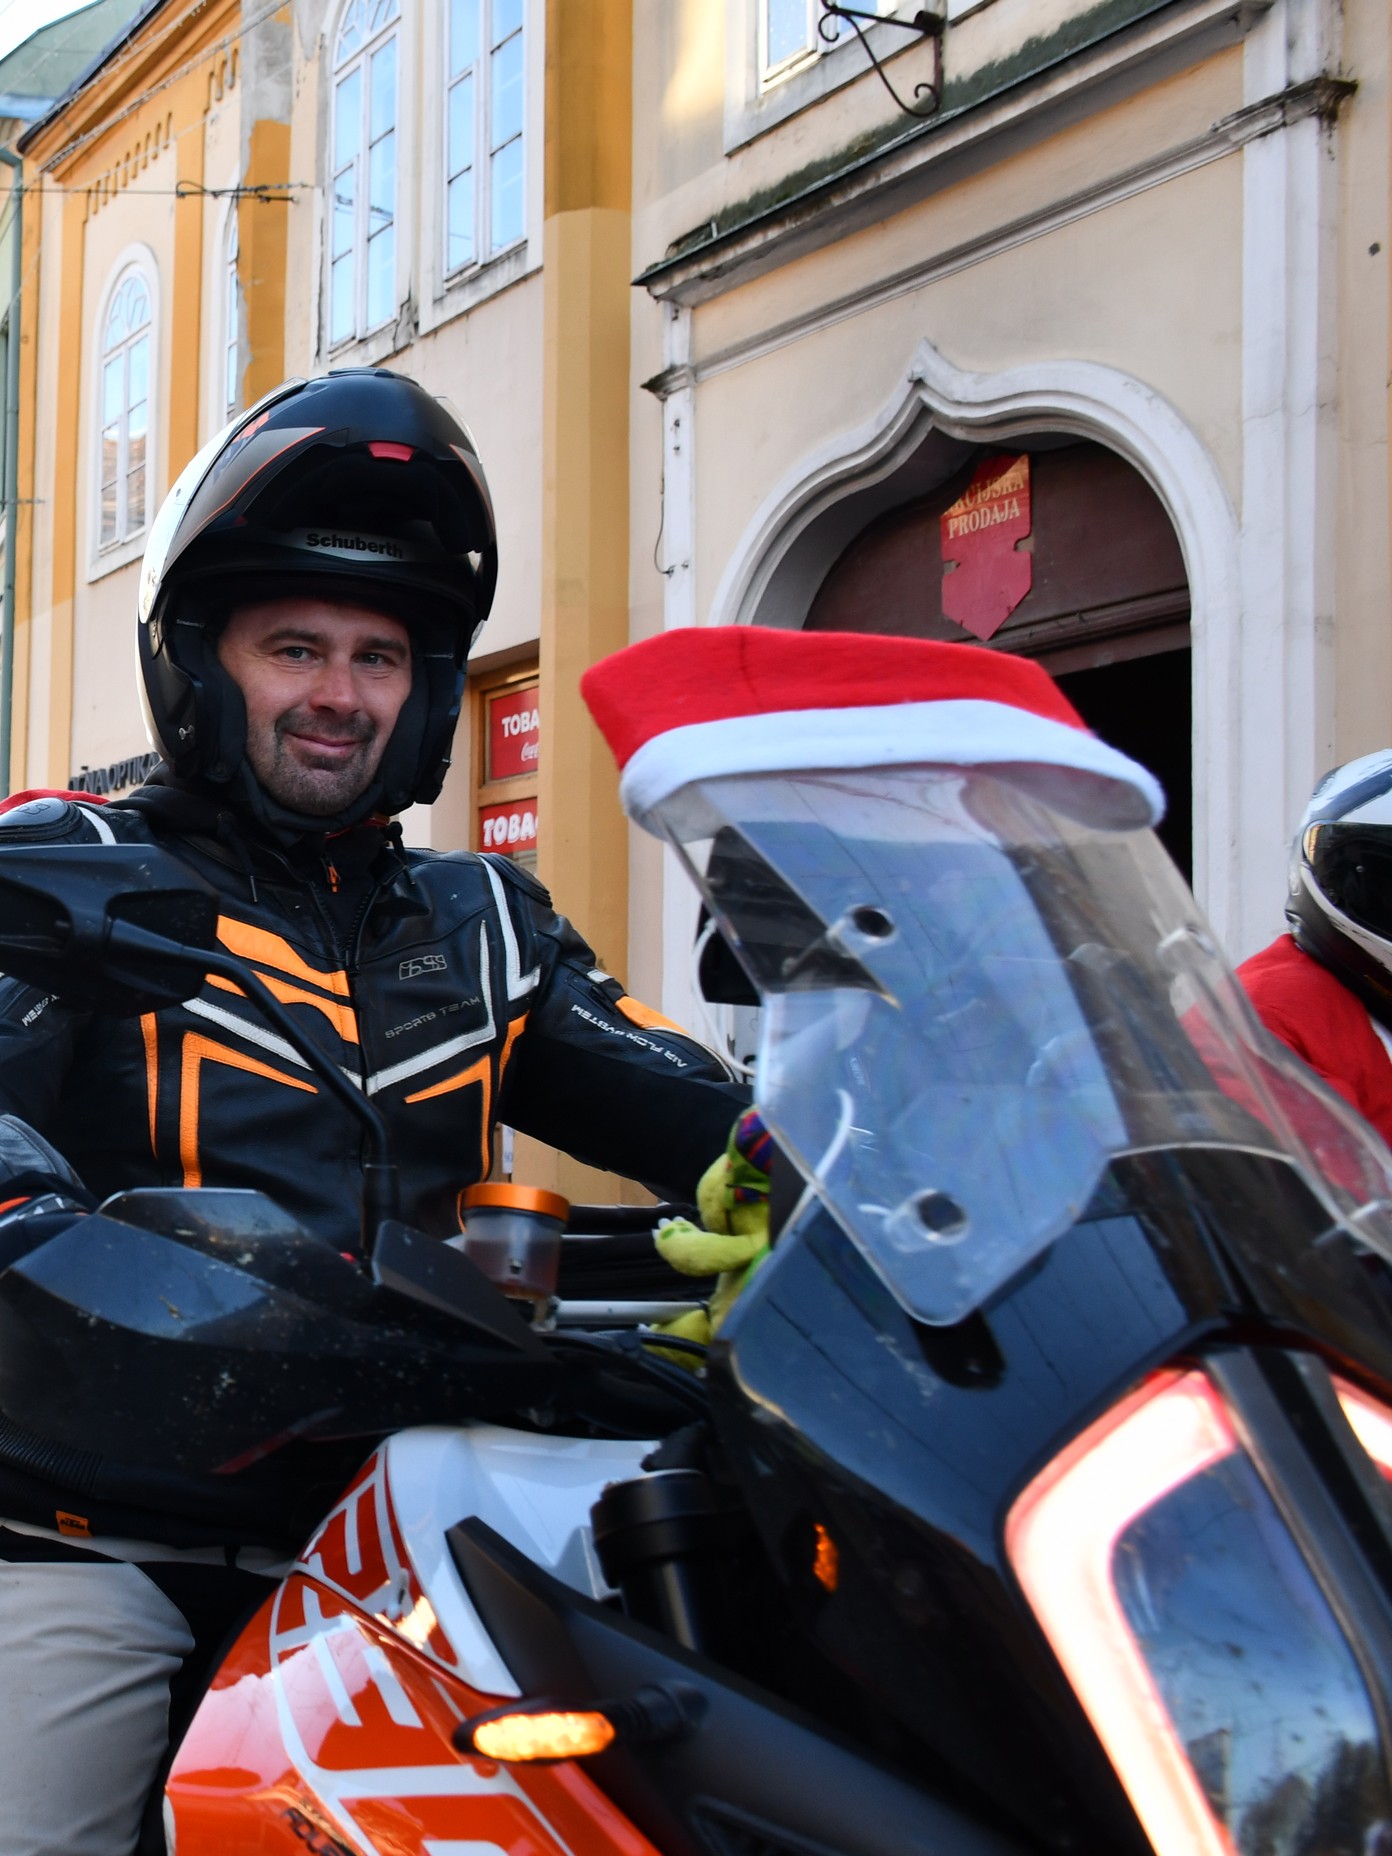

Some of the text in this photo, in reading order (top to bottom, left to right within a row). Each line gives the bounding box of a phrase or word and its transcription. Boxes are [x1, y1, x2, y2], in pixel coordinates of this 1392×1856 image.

[948, 497, 1020, 540] PRODAJA
[305, 532, 404, 559] Schuberth
[483, 812, 539, 847] TOBA
[384, 996, 481, 1039] SPORTS TEAM
[663, 1050, 688, 1068] AIR
